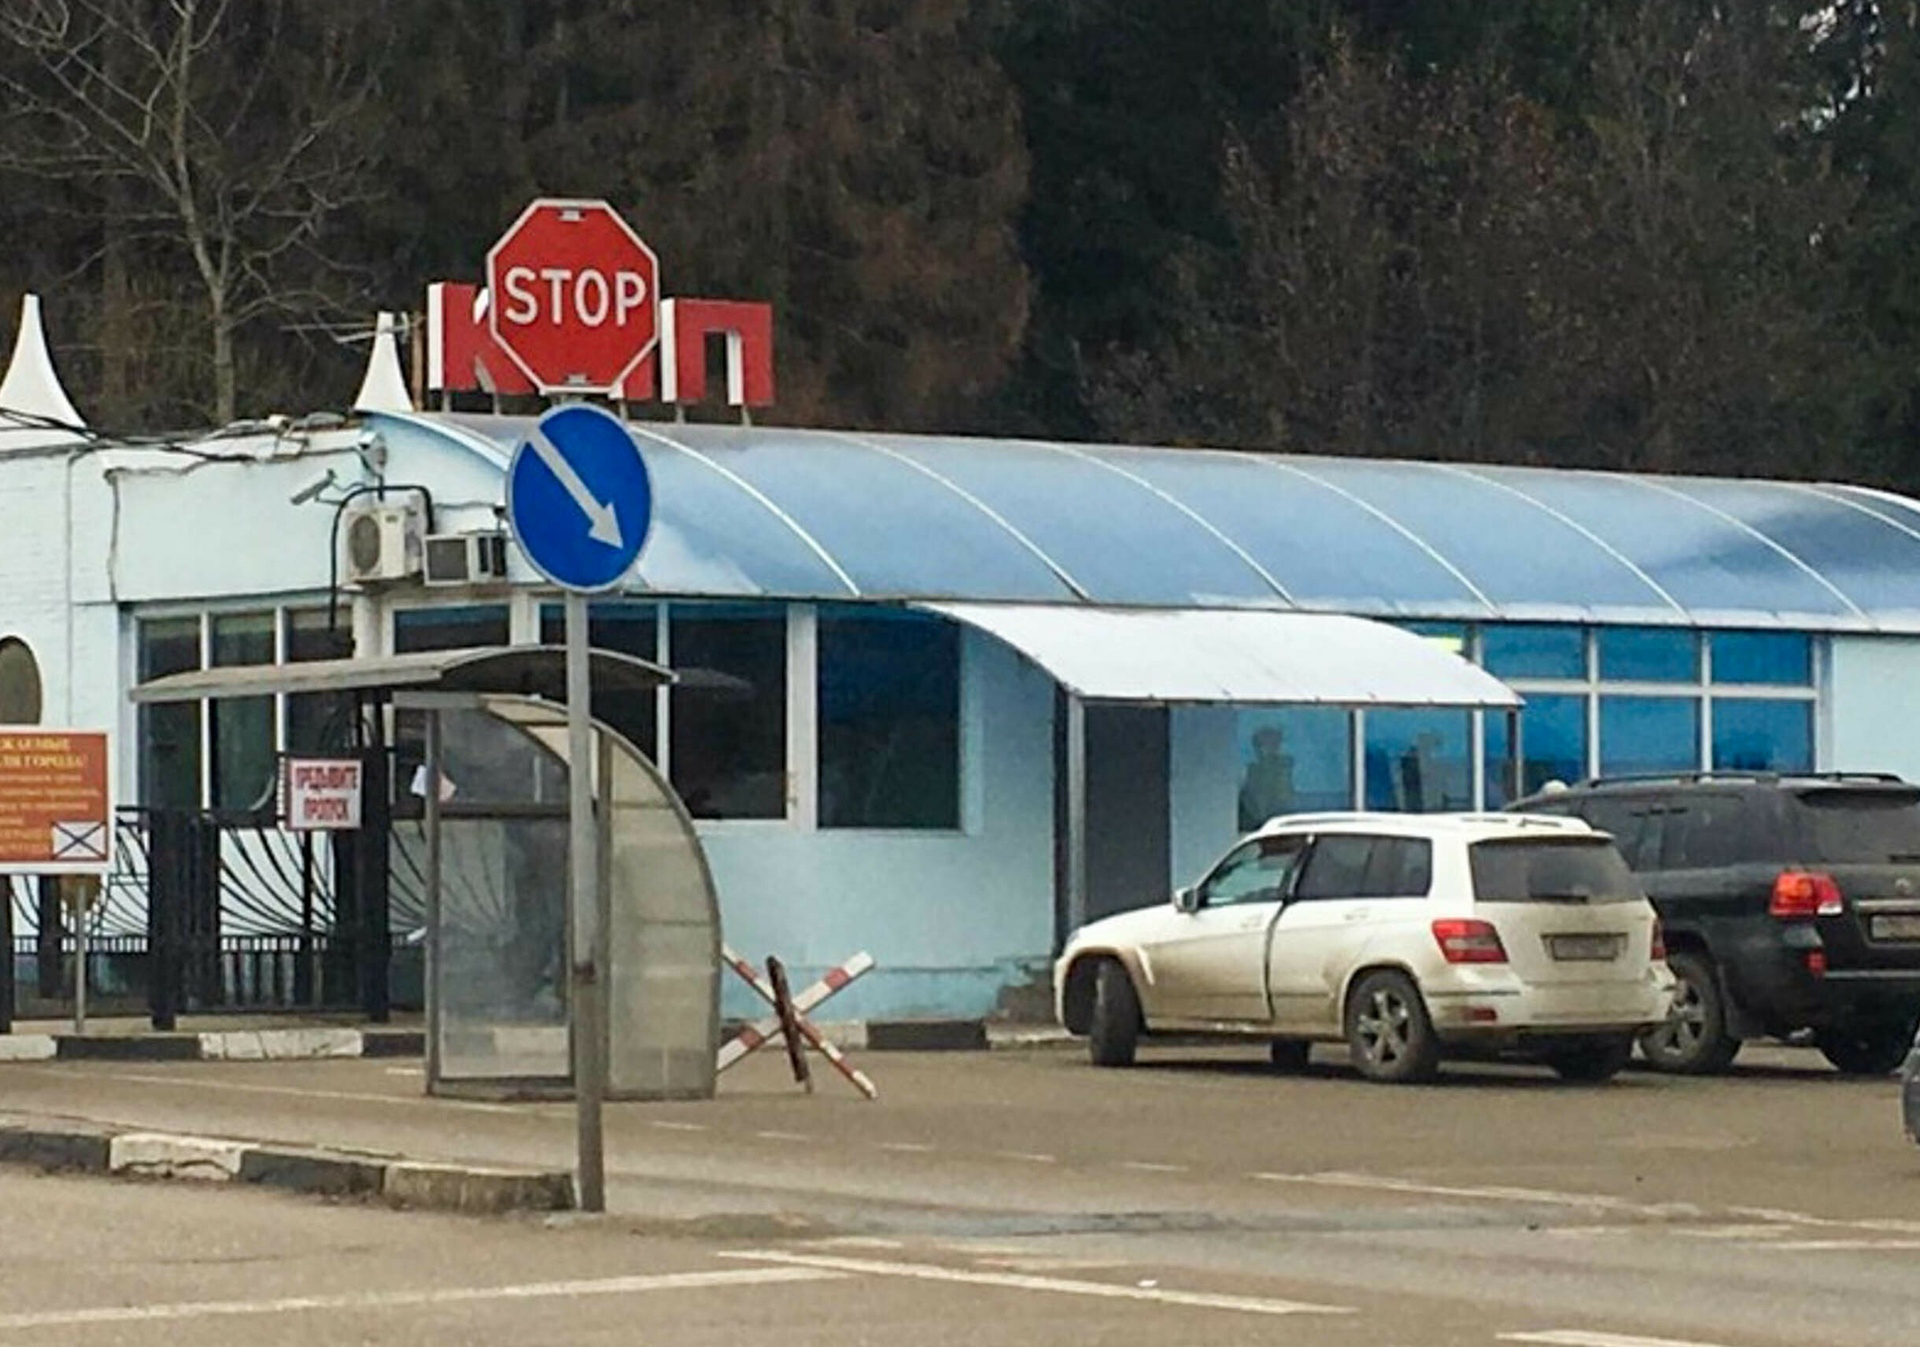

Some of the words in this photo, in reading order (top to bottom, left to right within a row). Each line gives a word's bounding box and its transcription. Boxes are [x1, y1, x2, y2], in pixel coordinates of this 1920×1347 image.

[504, 266, 648, 327] STOP
[428, 281, 775, 407] КП
[304, 797, 349, 820] ПРОПУСК
